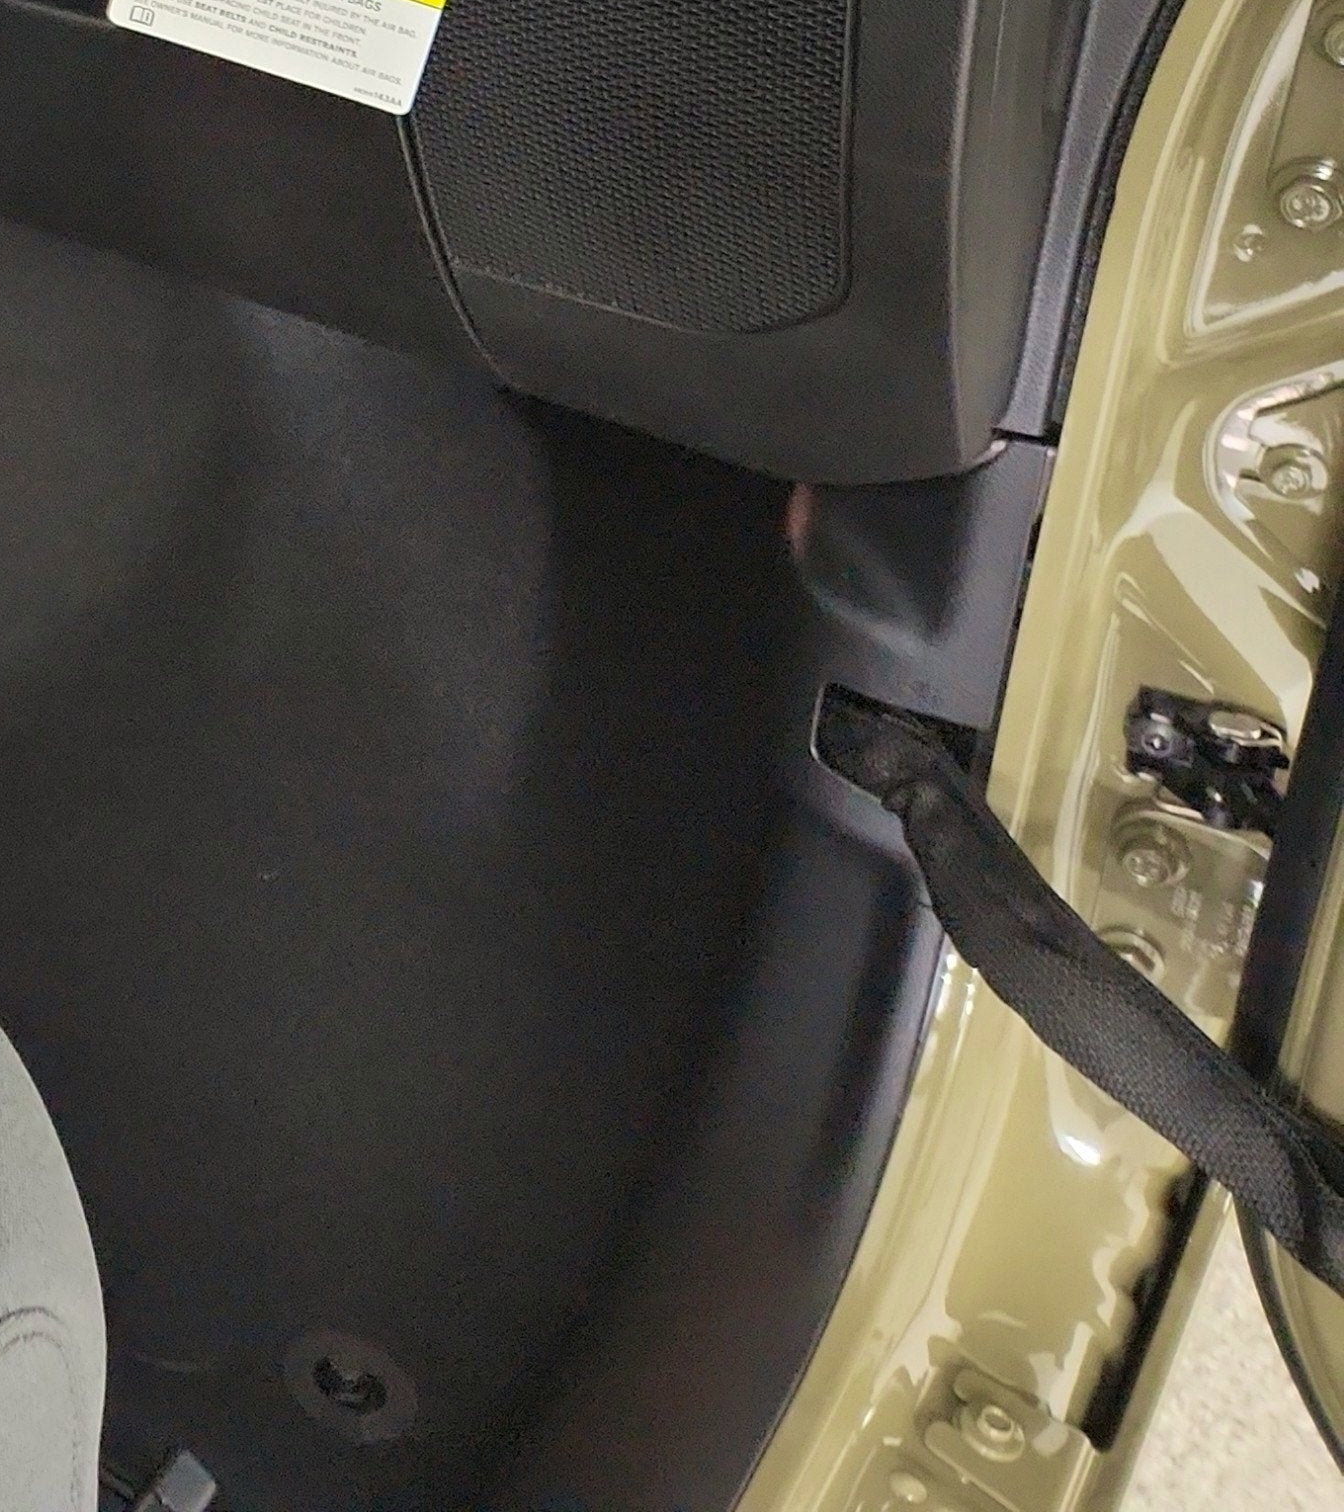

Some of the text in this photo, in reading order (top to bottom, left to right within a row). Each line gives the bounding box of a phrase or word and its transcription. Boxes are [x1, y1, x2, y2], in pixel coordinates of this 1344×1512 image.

[194, 1, 217, 14] SEAT
[218, 8, 246, 23] BELTS
[248, 17, 267, 29] AND
[267, 24, 297, 39] CHILD
